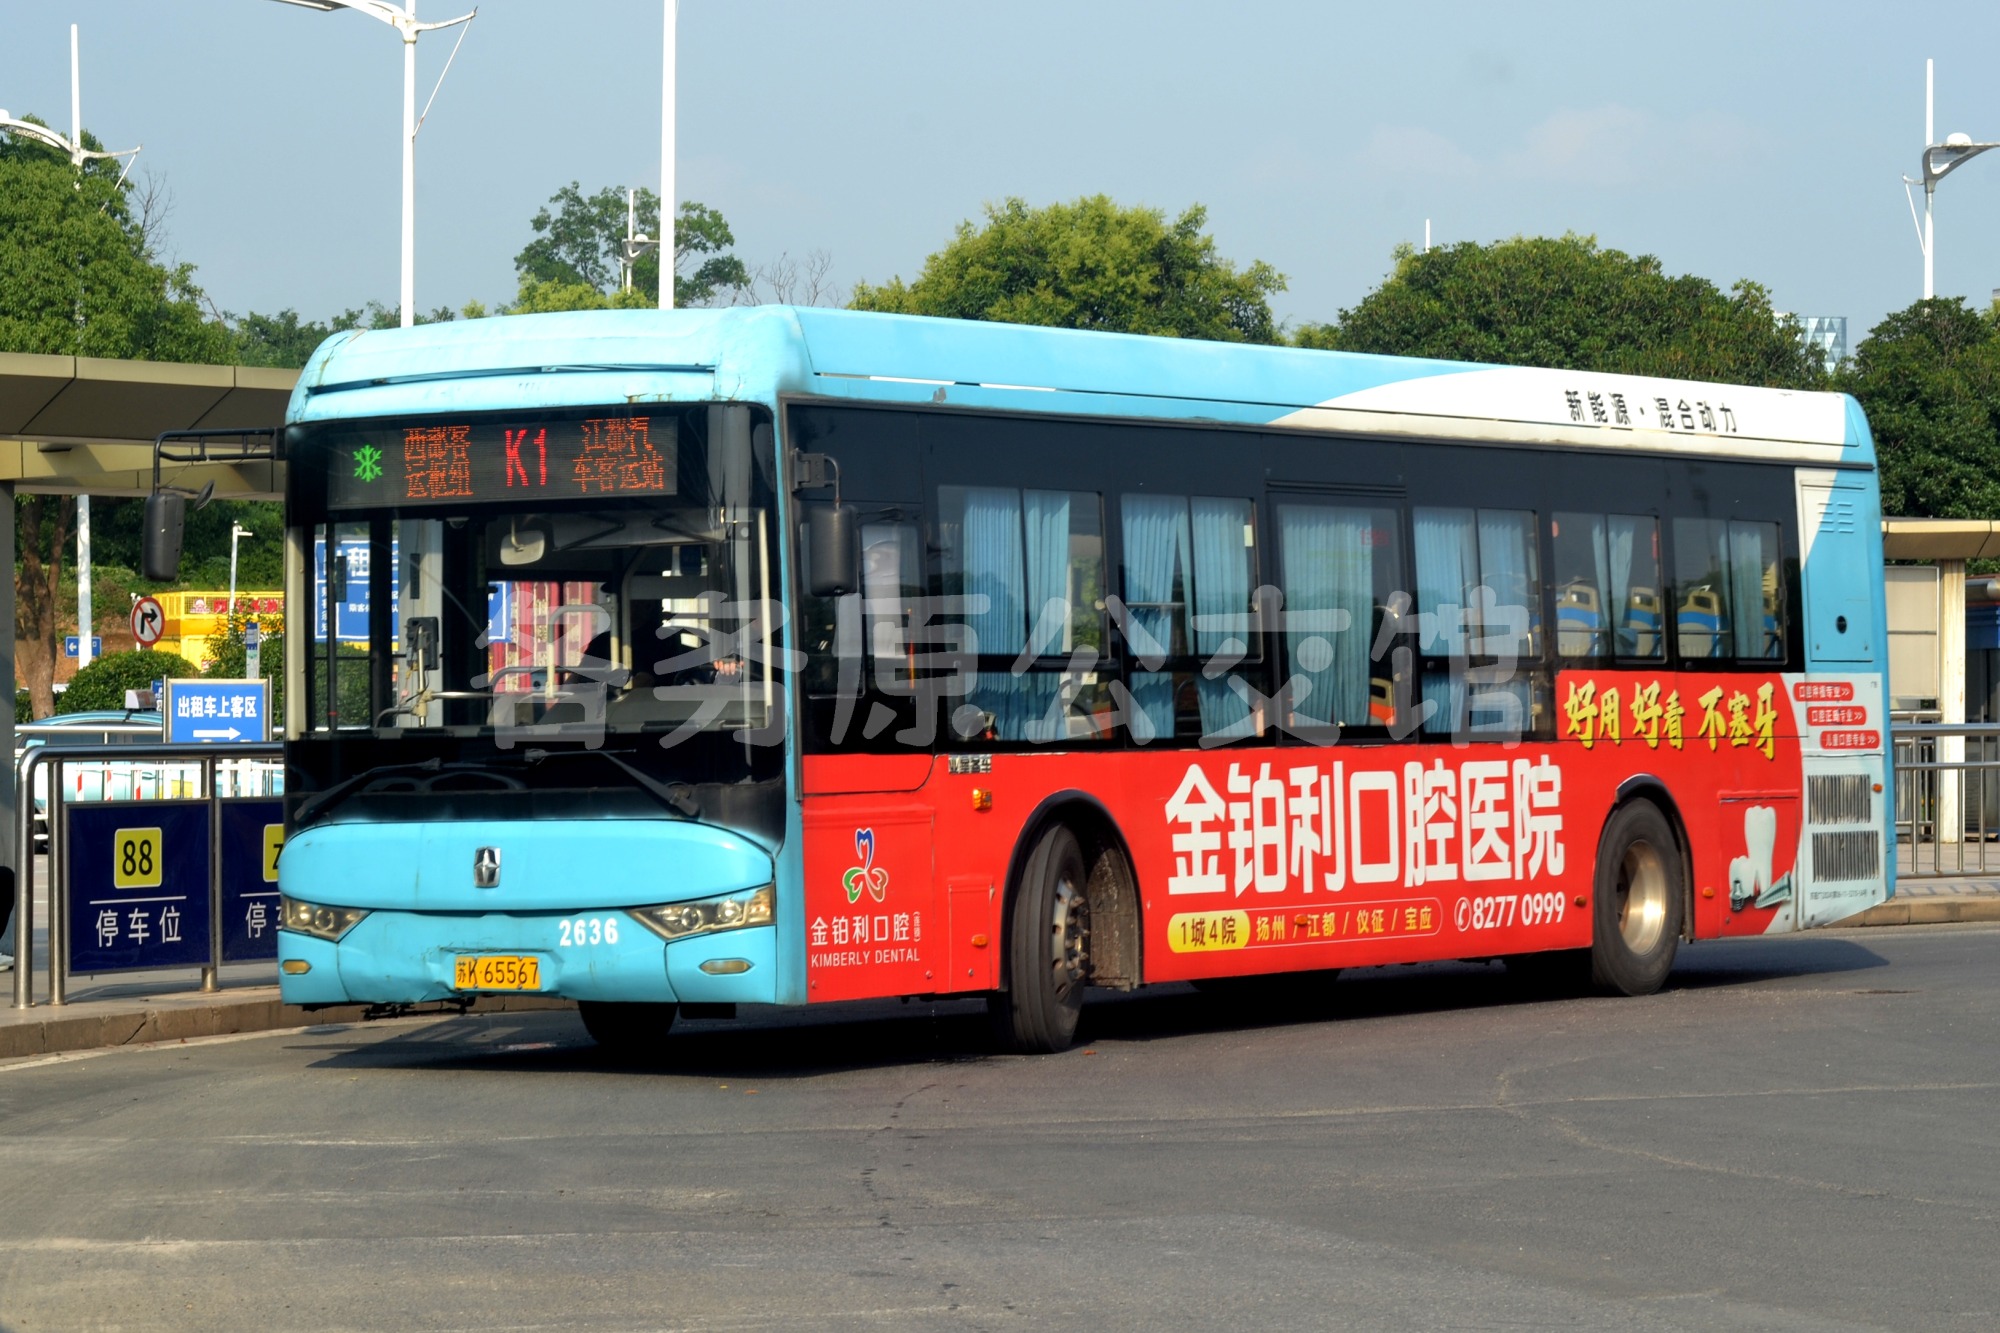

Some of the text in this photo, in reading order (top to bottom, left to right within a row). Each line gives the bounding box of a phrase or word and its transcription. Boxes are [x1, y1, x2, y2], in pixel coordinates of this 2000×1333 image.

[505, 428, 547, 487] K1
[178, 695, 257, 718] 出租车上客区
[1563, 679, 1778, 761] 好用 好看 不塞牙
[1165, 754, 1565, 898] 金铂利口腔医院
[122, 839, 153, 877] 88
[95, 905, 182, 948] 停车位
[245, 902, 283, 939] 停
[810, 912, 910, 946] 金铂利口腔
[1256, 915, 1286, 941] 扬州
[1356, 909, 1384, 935] 仪征
[1404, 905, 1432, 931] 宝应
[1472, 891, 1566, 930] 8277 0999
[559, 917, 618, 947] 2636
[811, 948, 920, 968] KIMBERLY DENTAL
